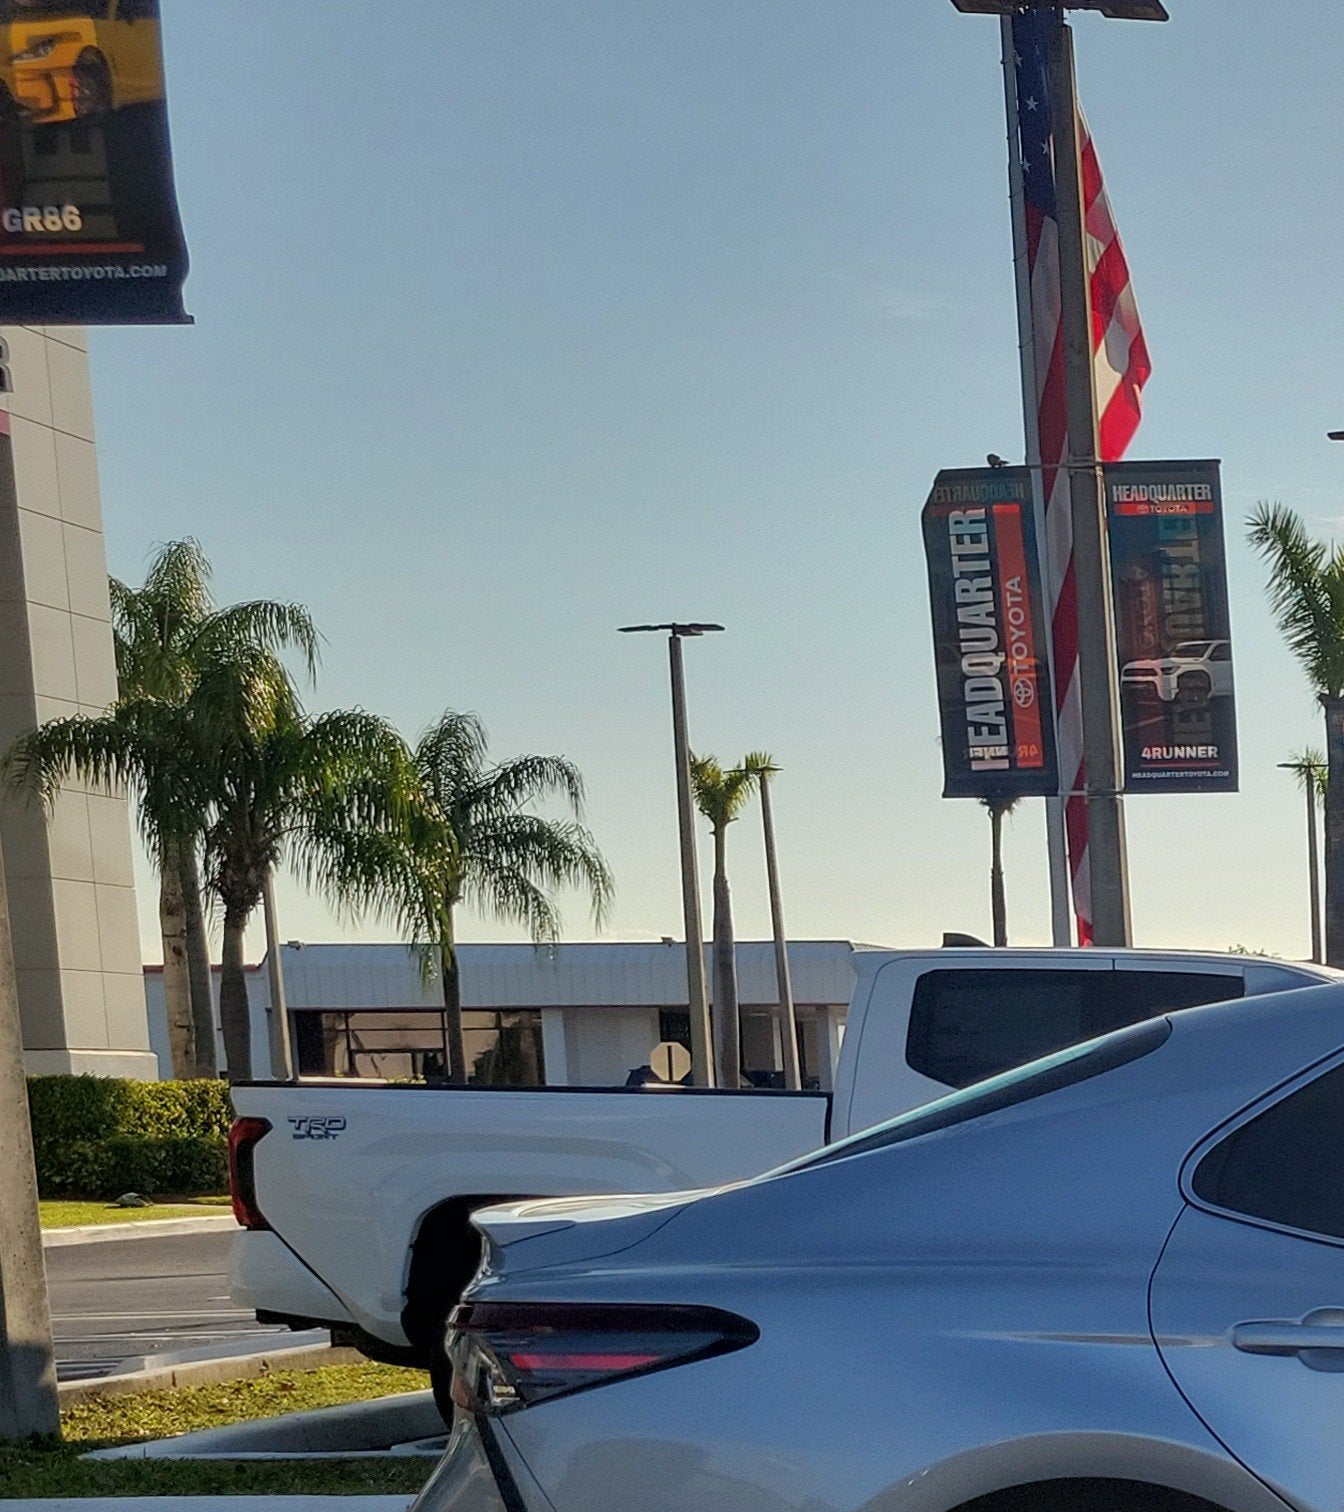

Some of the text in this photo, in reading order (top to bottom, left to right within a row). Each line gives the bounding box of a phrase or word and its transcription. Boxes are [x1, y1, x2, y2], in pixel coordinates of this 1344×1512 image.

[3, 205, 83, 232] GR86
[1112, 484, 1212, 503] HEADQUARTER
[1151, 505, 1187, 513] TOYOTA
[1005, 576, 1030, 674] TOYOTA
[949, 507, 1010, 771] HEADQUARTER
[1141, 746, 1218, 759] 4RUNNER
[287, 1116, 346, 1134] TRD
